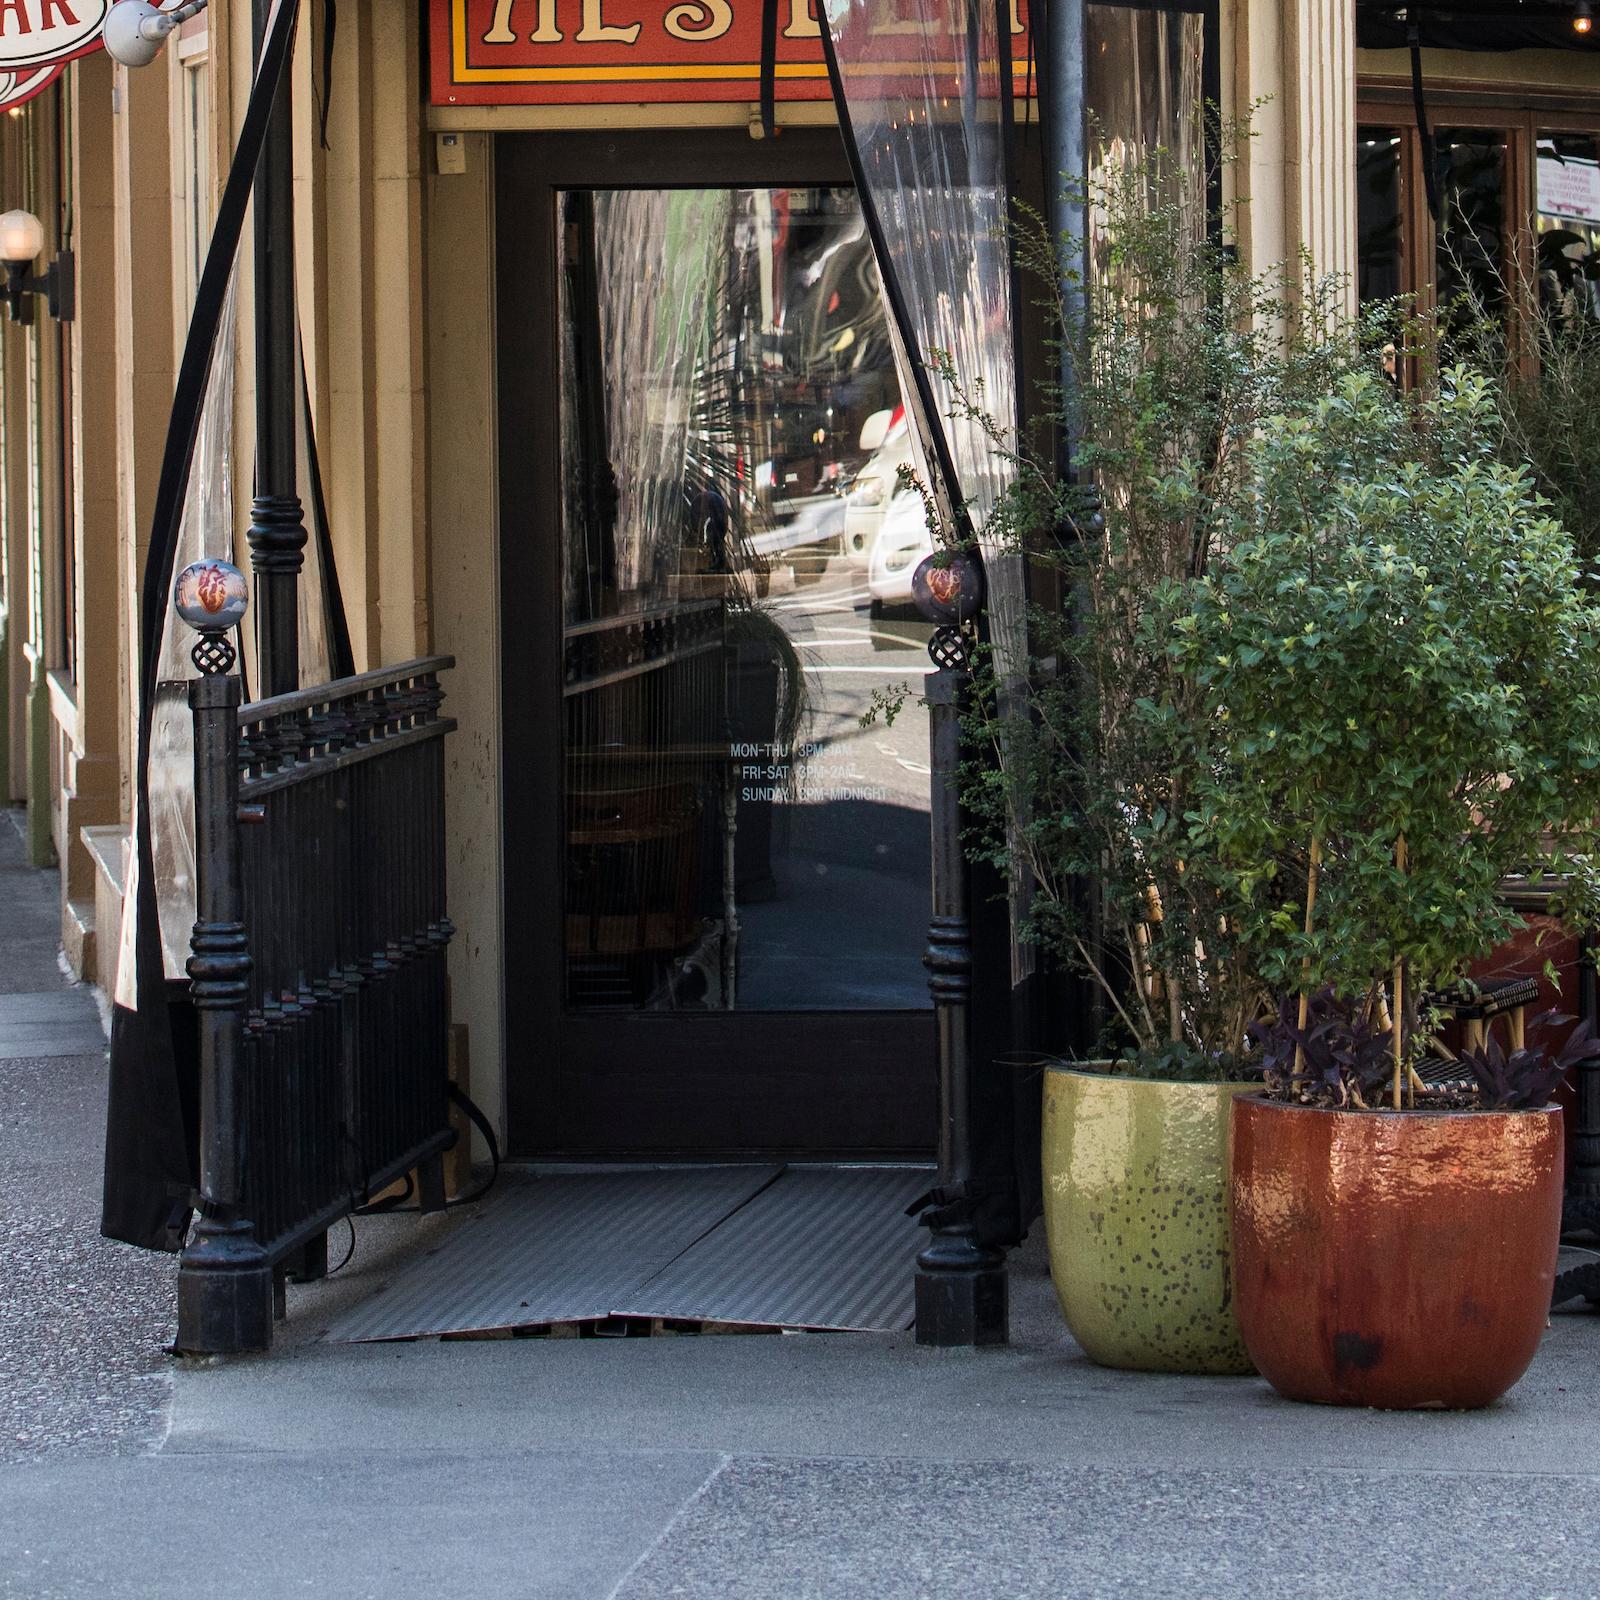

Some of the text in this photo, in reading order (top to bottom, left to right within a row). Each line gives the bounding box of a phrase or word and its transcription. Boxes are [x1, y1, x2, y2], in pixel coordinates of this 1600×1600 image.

[730, 743, 789, 758] MON-THU
[742, 765, 790, 780] FRI-SAT
[742, 787, 789, 802] SUNDAY
